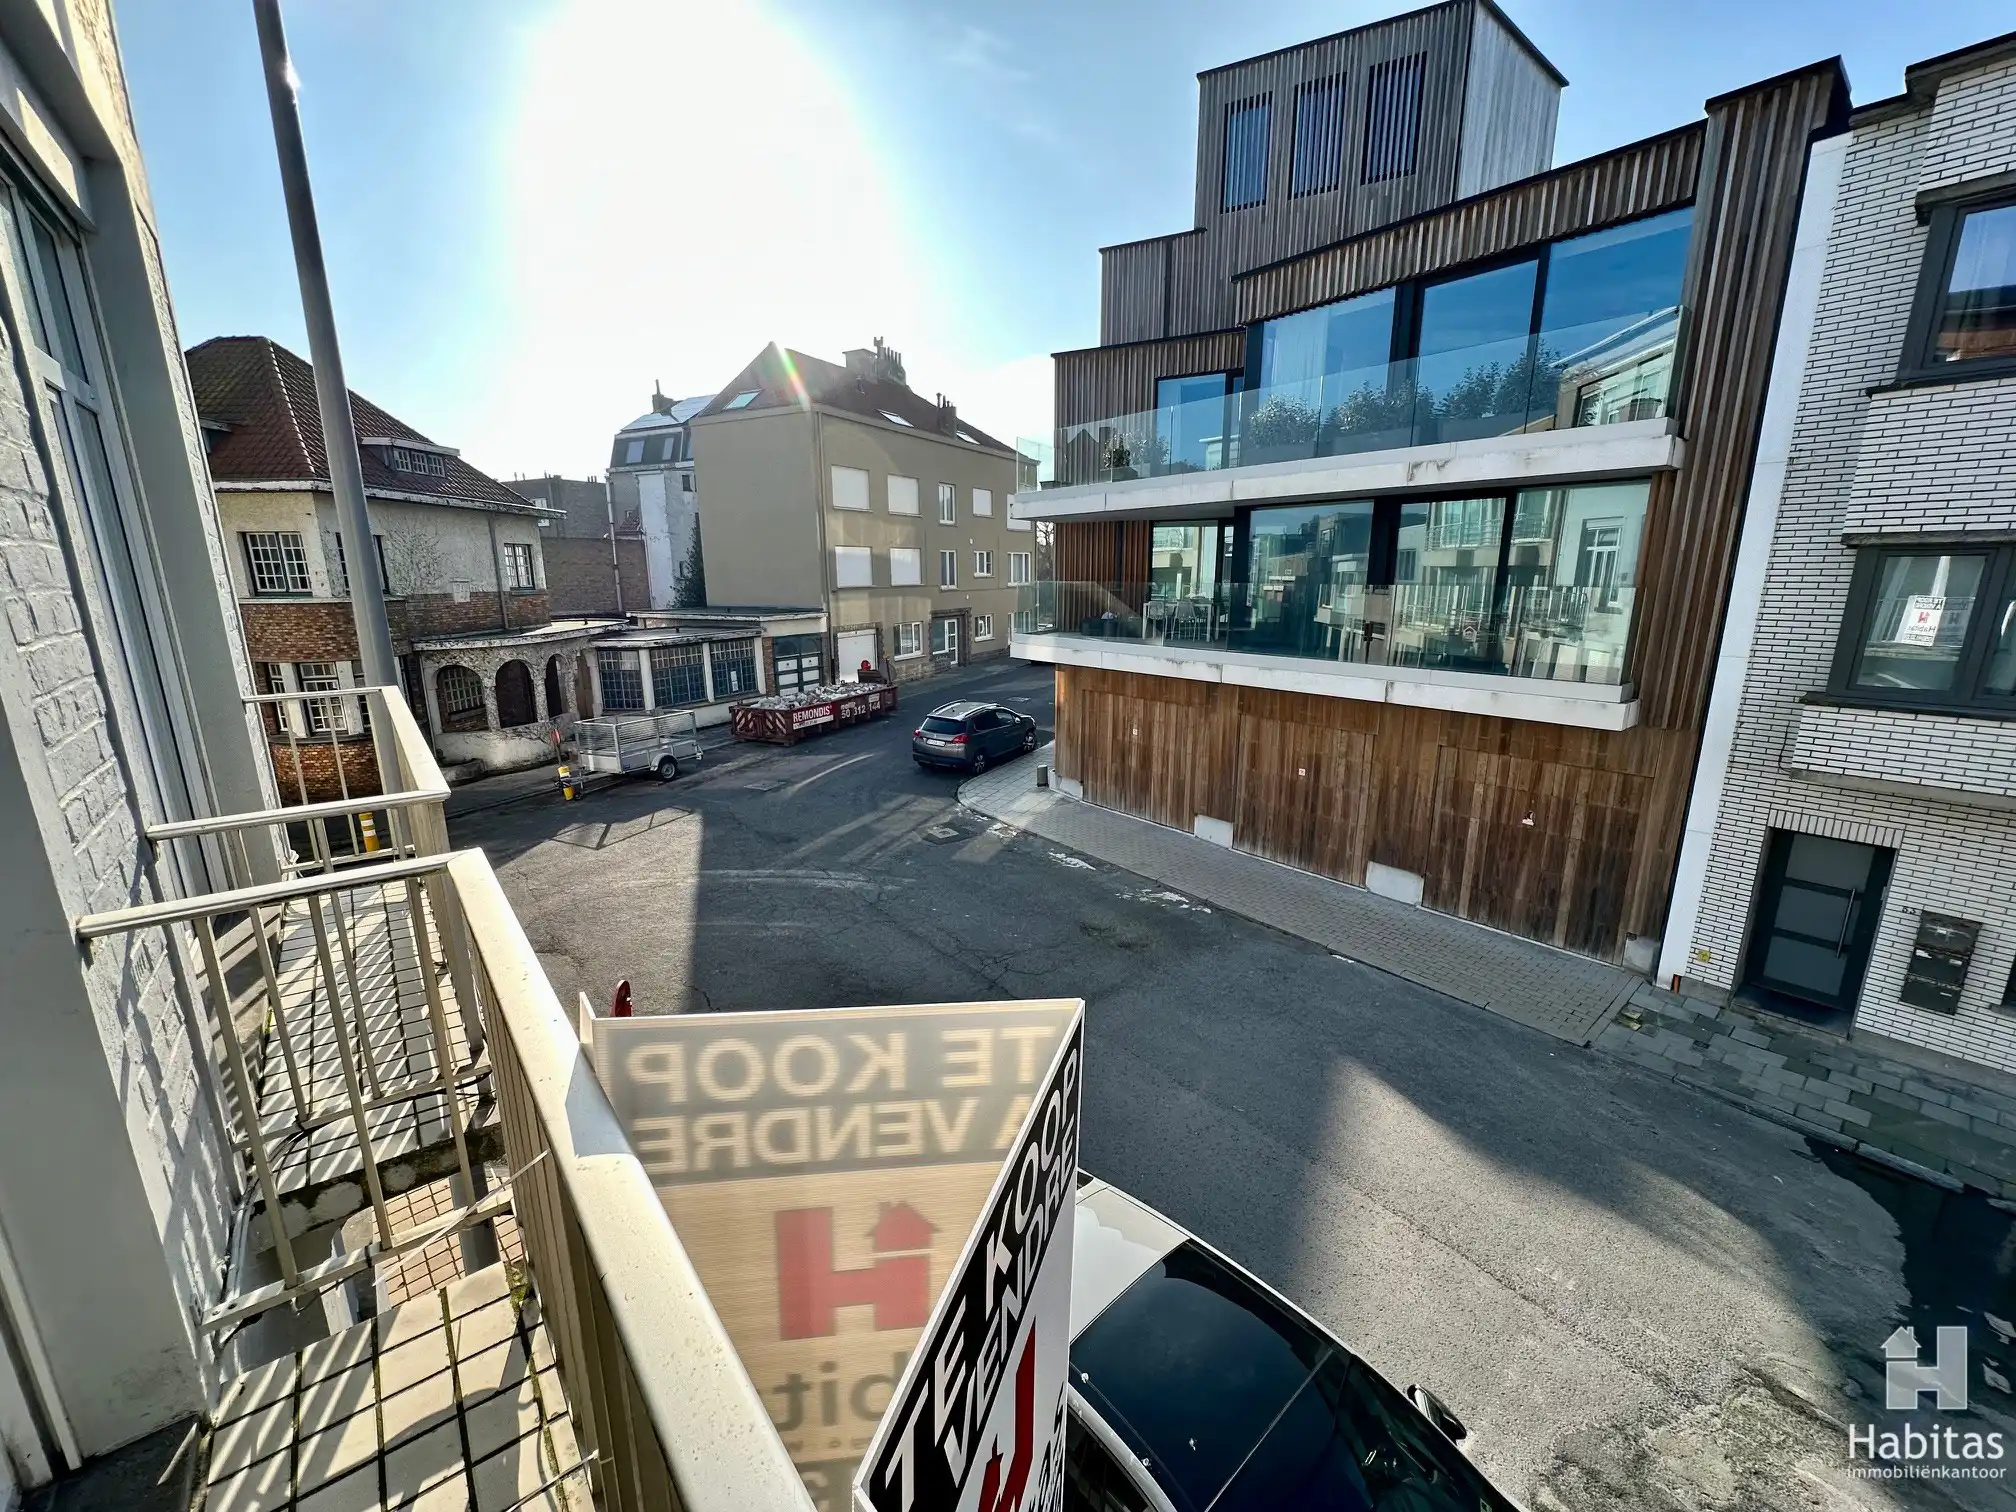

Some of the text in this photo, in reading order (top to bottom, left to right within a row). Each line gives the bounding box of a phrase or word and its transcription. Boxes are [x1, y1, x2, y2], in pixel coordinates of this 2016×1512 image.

[886, 1295, 966, 1512] TE
[986, 1048, 1077, 1322] KOOP
[944, 1113, 1075, 1489] VENDRE
